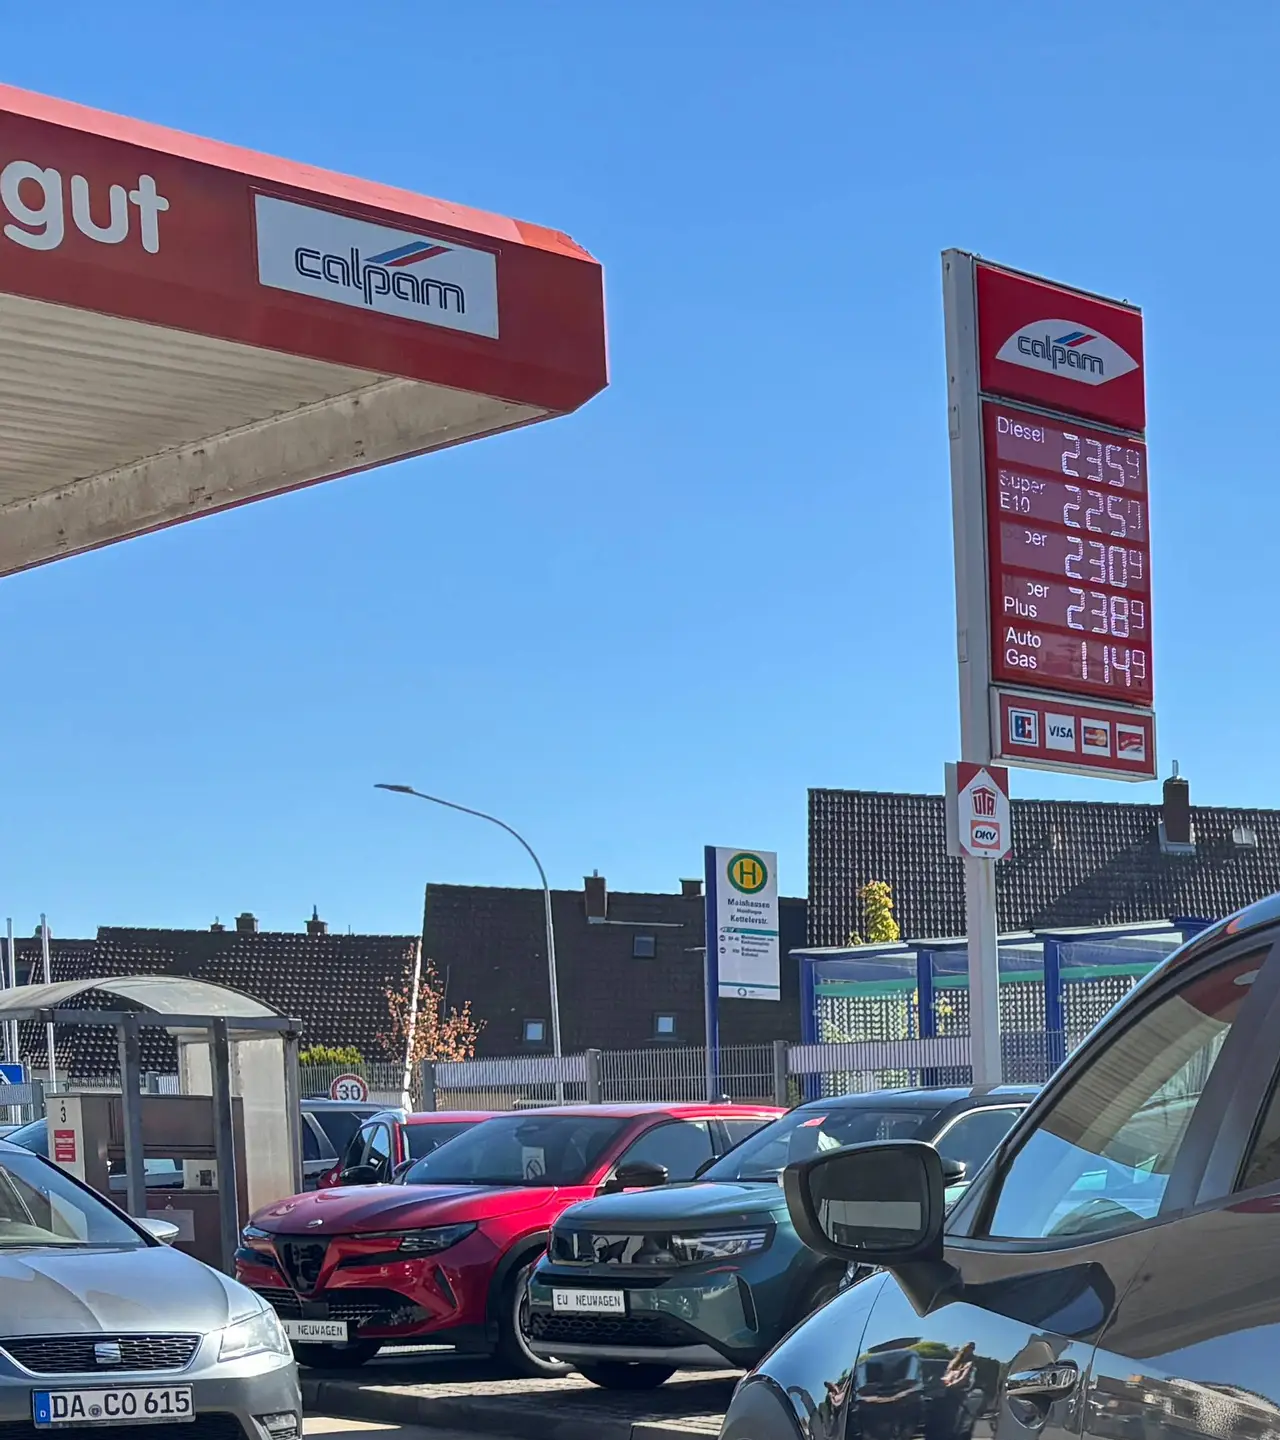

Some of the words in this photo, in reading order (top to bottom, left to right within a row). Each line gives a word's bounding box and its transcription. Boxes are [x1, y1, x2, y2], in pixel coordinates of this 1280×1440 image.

[0, 160, 170, 254] gut
[294, 246, 466, 314] calpam
[1016, 335, 1105, 376] calpam
[996, 416, 1045, 443] Diesel
[1000, 491, 1030, 514] E10
[1003, 596, 1038, 618] Plus
[1005, 626, 1042, 648] Auto
[1006, 648, 1038, 669] Gas
[1049, 724, 1074, 739] VISA
[975, 829, 997, 841] DKV
[739, 861, 757, 885] H
[338, 1084, 361, 1101] 30
[557, 1294, 568, 1305] EU
[576, 1294, 621, 1307] NEUWAGEN
[297, 1324, 343, 1336] NEUWAGEN
[51, 1394, 86, 1418] DA
[104, 1392, 137, 1416] CO
[144, 1390, 190, 1414] 615
